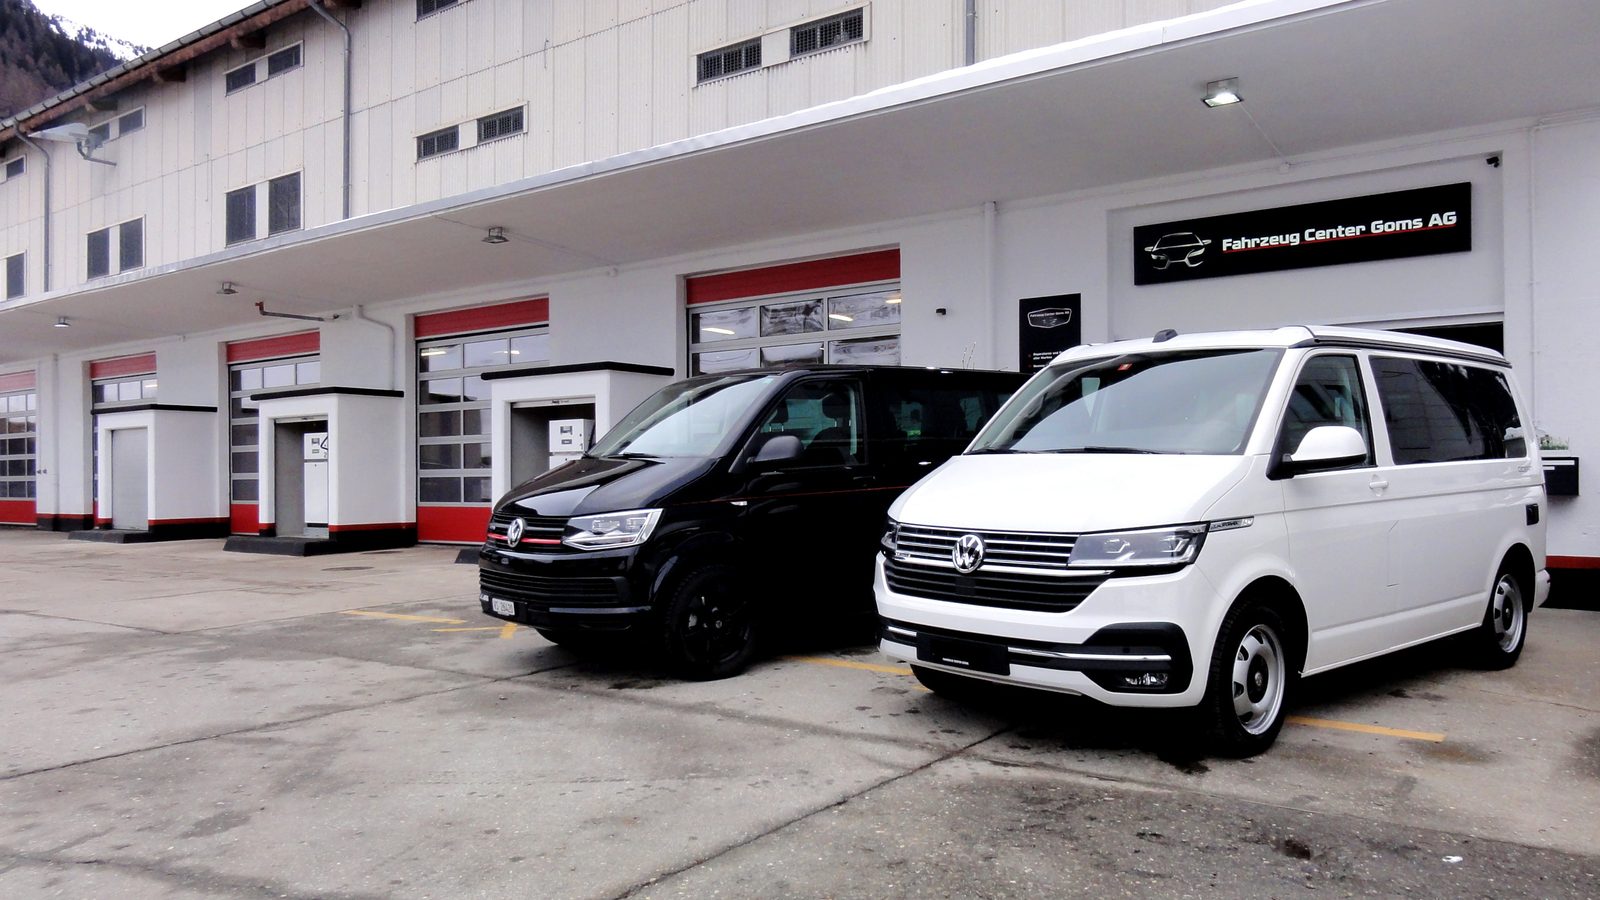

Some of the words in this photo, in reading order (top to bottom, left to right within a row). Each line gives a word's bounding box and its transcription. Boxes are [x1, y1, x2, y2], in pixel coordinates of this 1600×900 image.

[1222, 232, 1300, 252] Fahrzeug
[1304, 224, 1366, 242] Center
[1370, 218, 1423, 234] Goms
[1428, 211, 1457, 227] AG
